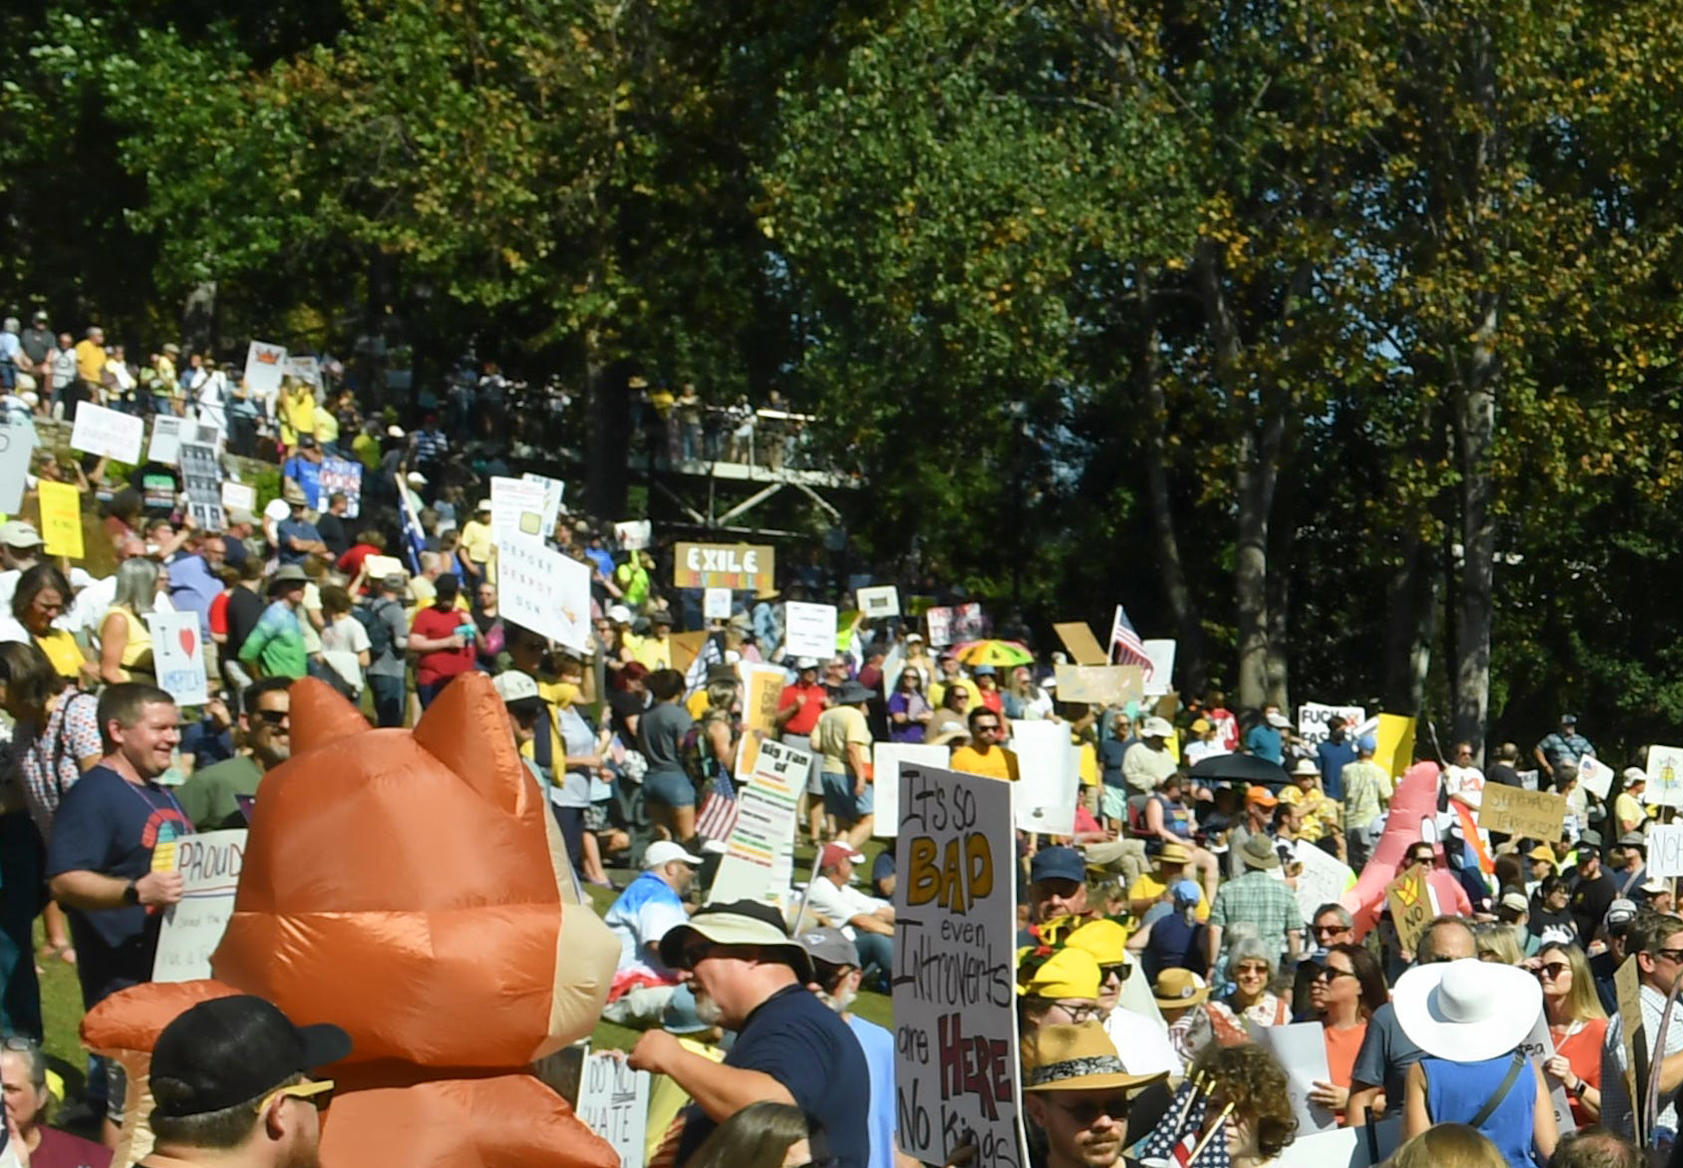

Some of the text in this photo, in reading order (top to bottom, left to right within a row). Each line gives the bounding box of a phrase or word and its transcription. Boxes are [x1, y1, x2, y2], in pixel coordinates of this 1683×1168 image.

[686, 547, 759, 574] EXILE
[901, 769, 948, 832] It's
[178, 842, 244, 882] PROUD
[906, 831, 994, 918] BAD
[940, 917, 987, 948] even
[1404, 908, 1425, 928] NO
[892, 918, 1012, 1008] Introverts
[898, 1012, 1013, 1123] are HERE
[898, 1078, 931, 1151] No
